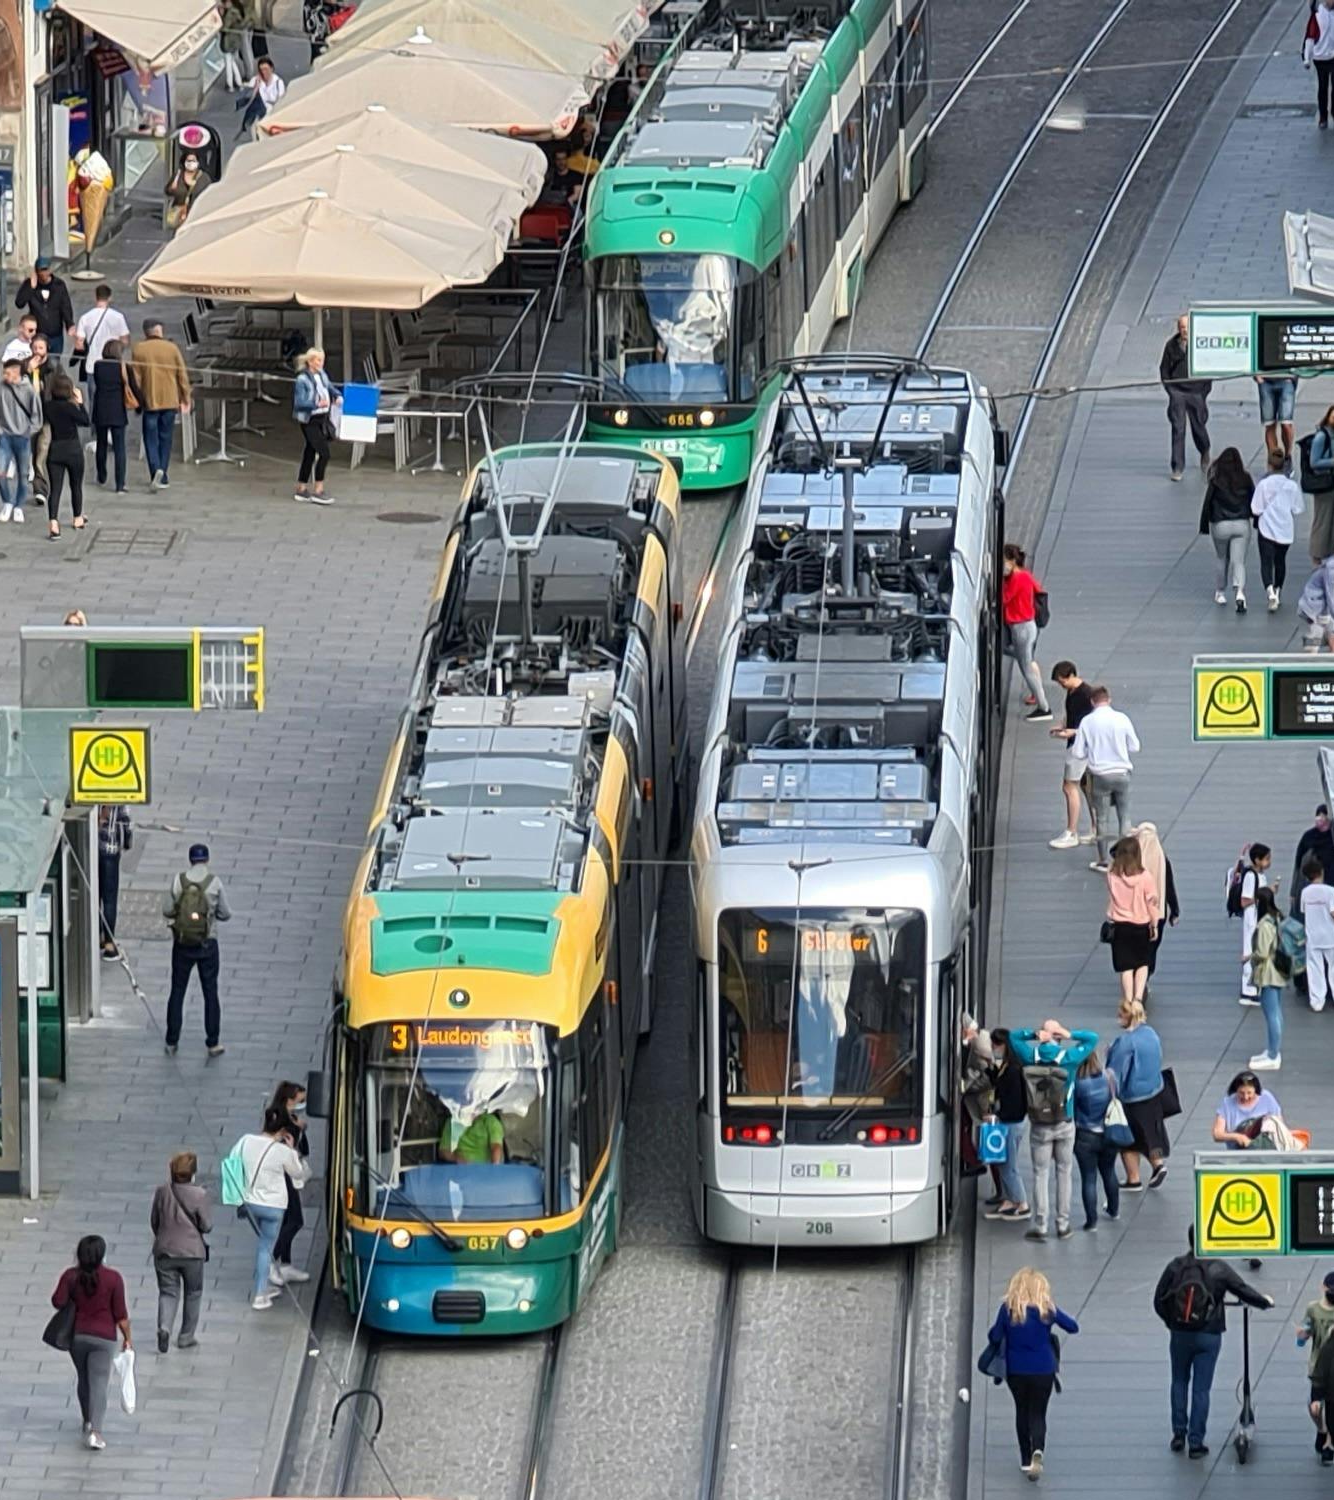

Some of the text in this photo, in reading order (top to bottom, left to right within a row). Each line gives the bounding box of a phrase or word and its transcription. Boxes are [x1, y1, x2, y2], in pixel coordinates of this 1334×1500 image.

[757, 929, 768, 953] 6
[392, 1024, 408, 1050] 3
[806, 1222, 833, 1234] 208
